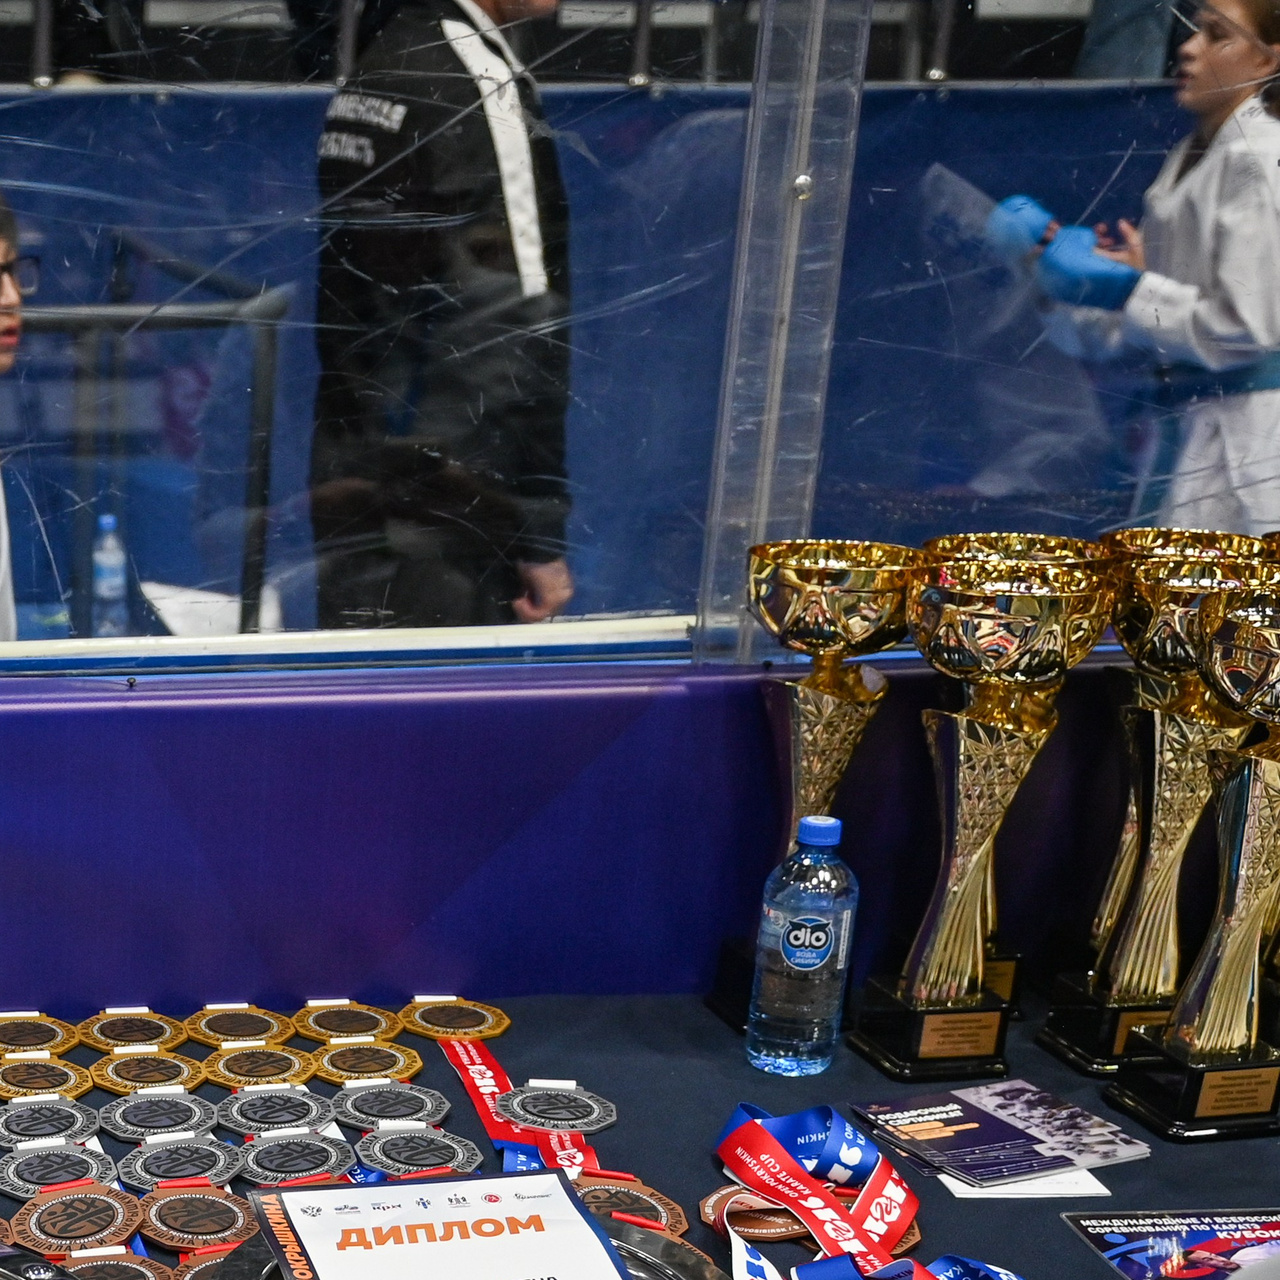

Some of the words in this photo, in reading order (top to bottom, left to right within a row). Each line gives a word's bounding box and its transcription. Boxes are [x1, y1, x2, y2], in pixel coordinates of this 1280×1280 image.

[789, 928, 827, 946] dio
[877, 1103, 961, 1122] ПОДАРОЧНЫЙ
[888, 1111, 964, 1127] СЕРТИФИКАТ
[734, 1146, 786, 1191] POKRYSHKIN
[759, 1153, 781, 1172] CUP
[770, 1164, 811, 1195] KARATE
[782, 1180, 800, 1198] OPEN
[1081, 1217, 1200, 1228] МЕЖДУНАРОДНЫЕ
[1088, 1225, 1191, 1234] СОРЕВНОВАНИЯ
[1196, 1224, 1211, 1232] ПО
[1213, 1223, 1260, 1232] КАРАТЭ
[336, 1215, 545, 1250] ДИПЛОМ
